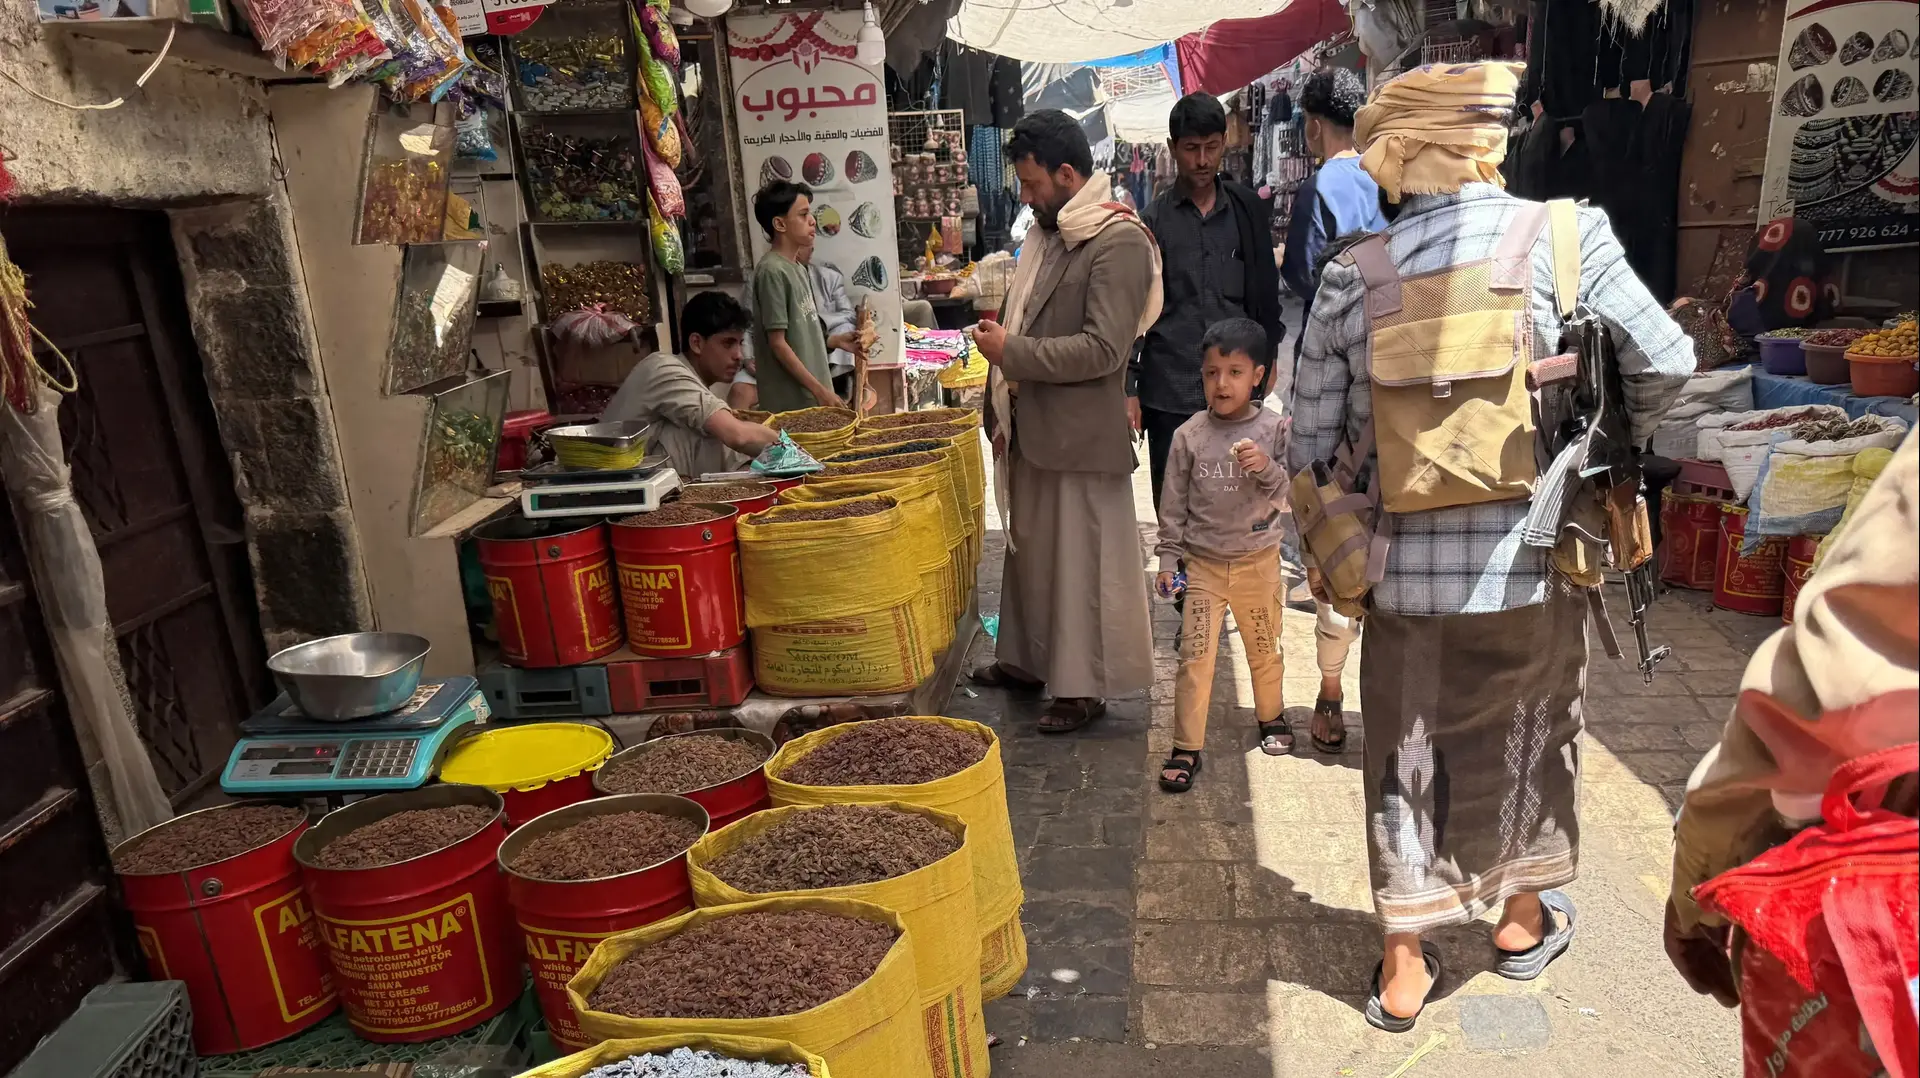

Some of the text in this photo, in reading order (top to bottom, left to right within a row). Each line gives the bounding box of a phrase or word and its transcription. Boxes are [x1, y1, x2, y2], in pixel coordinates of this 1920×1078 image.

[742, 83, 877, 122] محبوب
[743, 127, 884, 147] للفضيات والعقيق والأحجار الكريمة
[1818, 229, 1845, 242] 777
[1849, 226, 1877, 239] 926
[1881, 224, 1909, 237] 624
[1736, 539, 1788, 557] AFAT
[793, 652, 859, 662] ARASCOM
[353, 952, 411, 964] petroleum
[414, 943, 443, 958] Jelly
[525, 933, 600, 963] ALFA
[377, 956, 428, 972] COMPANY
[431, 949, 453, 963] FOR
[543, 963, 572, 973] white
[369, 972, 389, 981] AND
[391, 961, 444, 980] INDUSTRY
[388, 984, 430, 999] GREASE
[397, 996, 417, 1006] LBS
[426, 996, 478, 1021] 777788261
